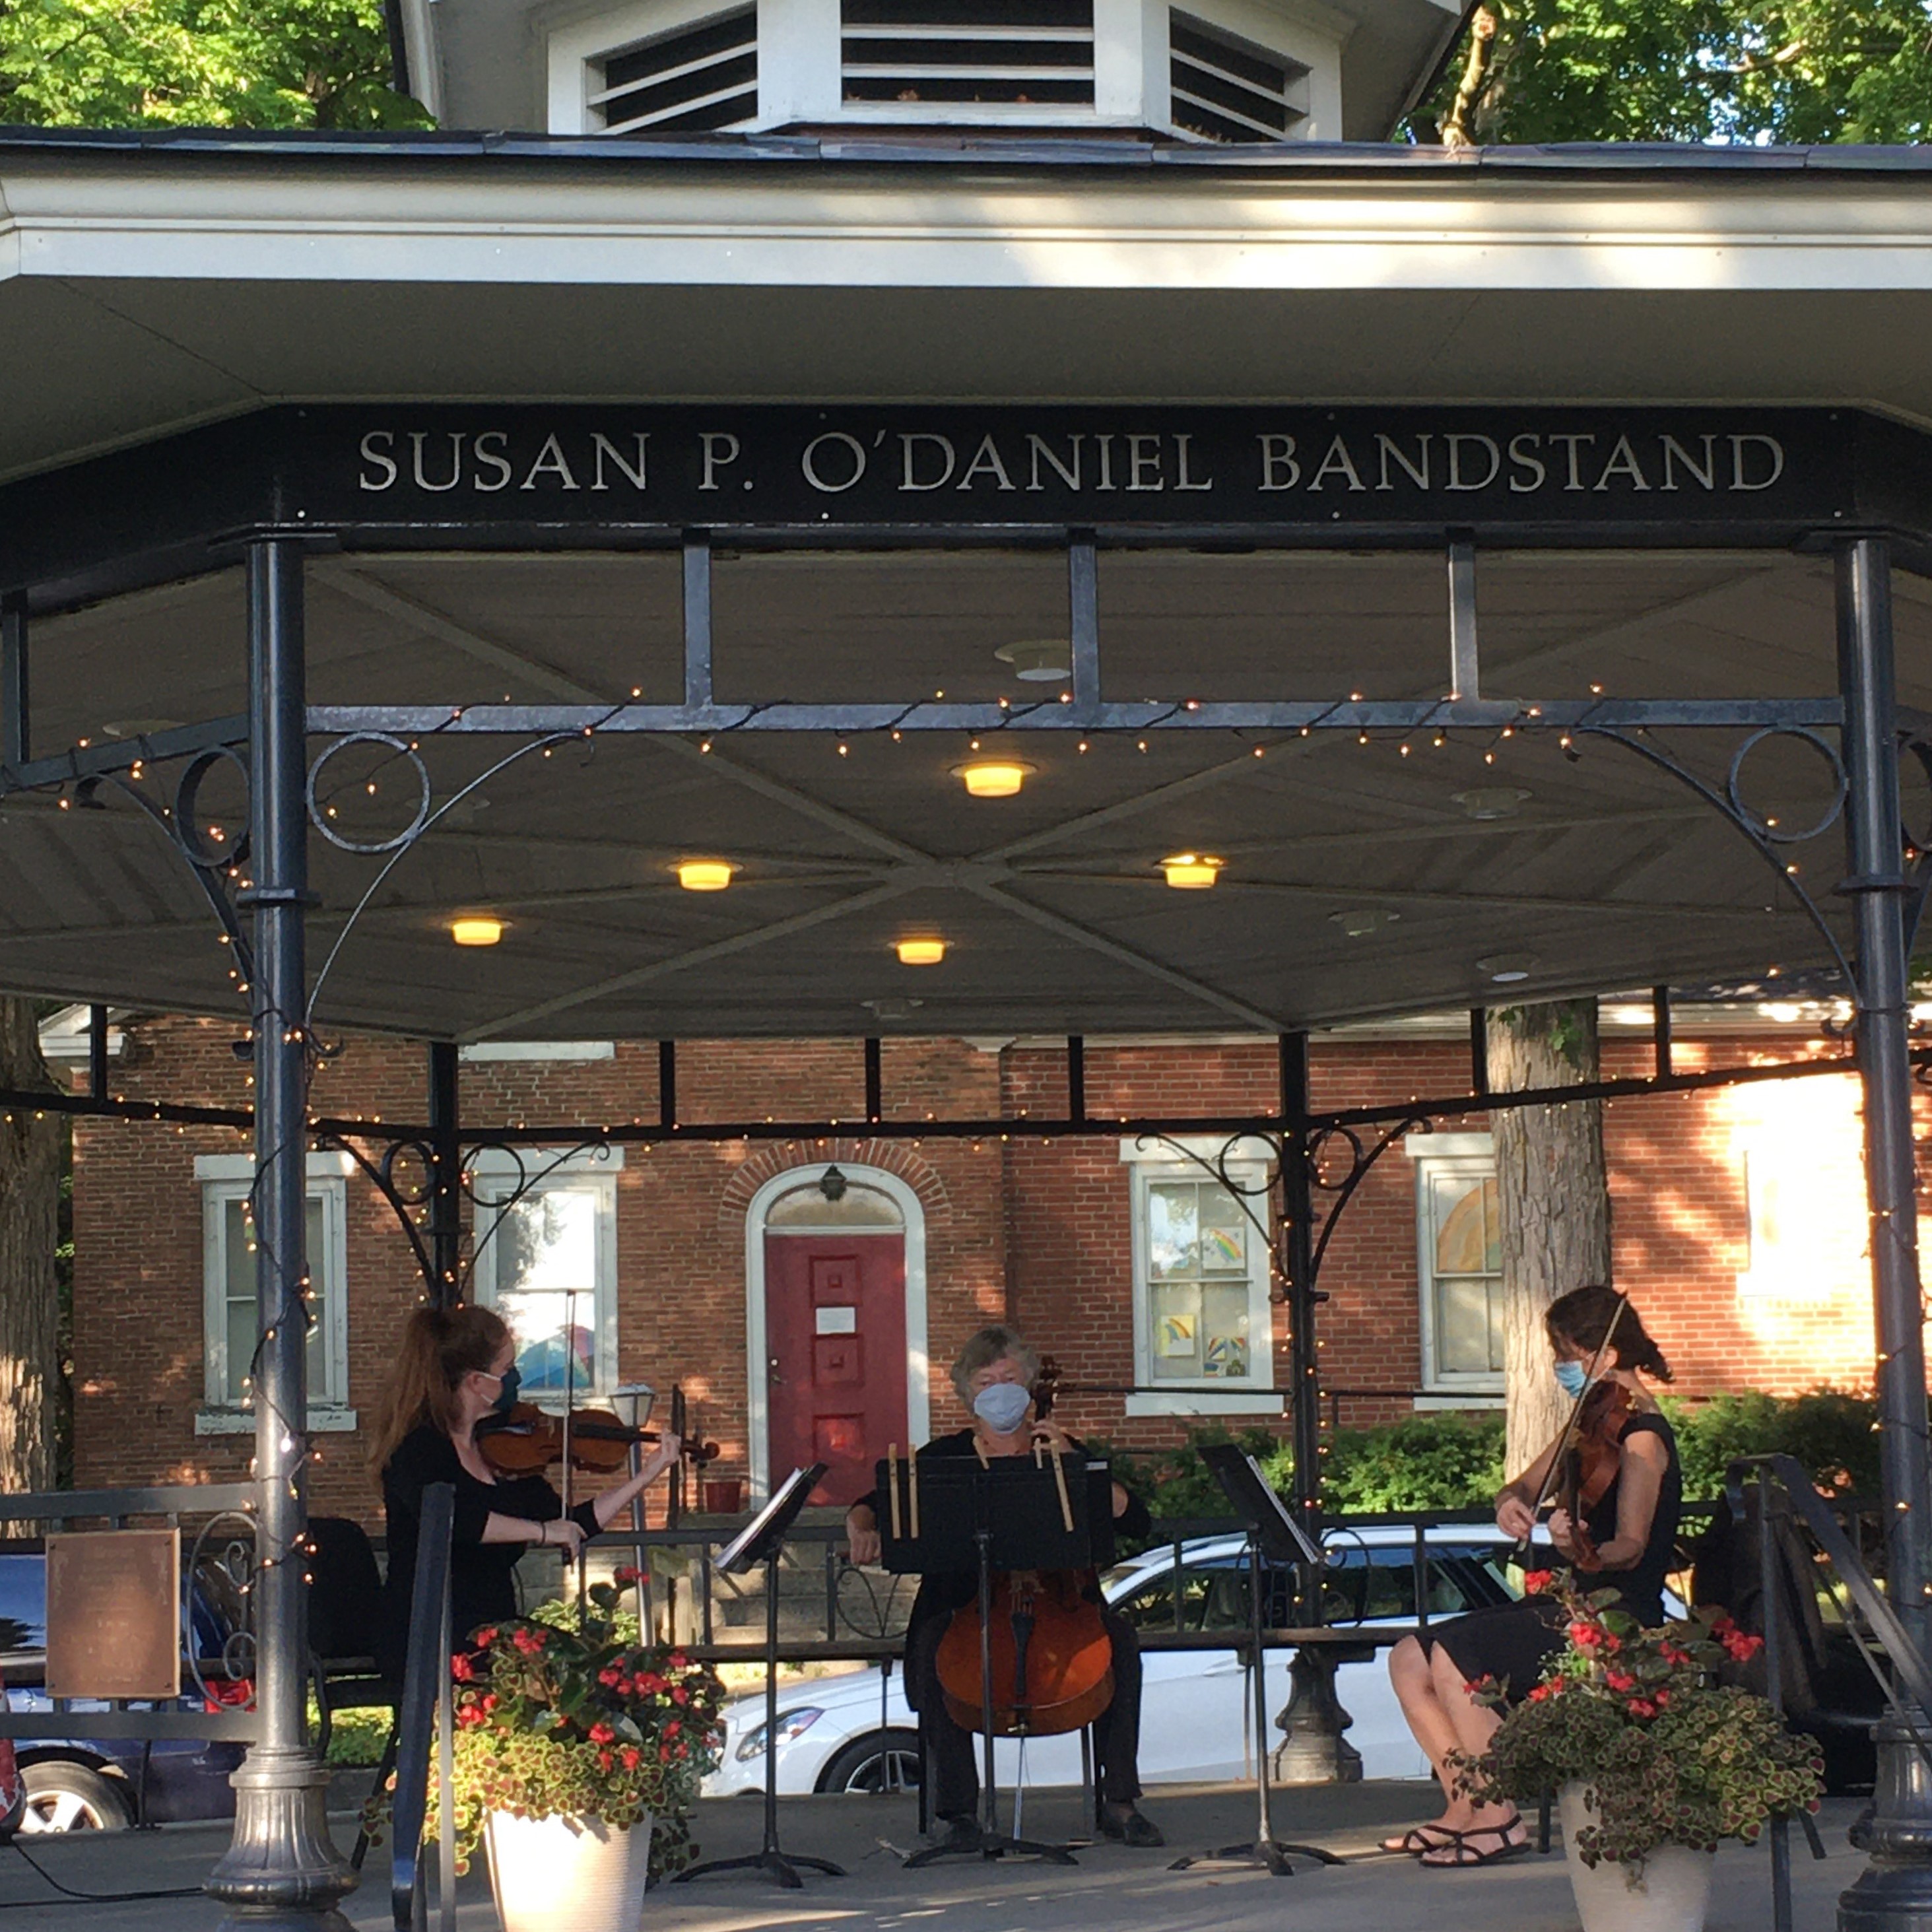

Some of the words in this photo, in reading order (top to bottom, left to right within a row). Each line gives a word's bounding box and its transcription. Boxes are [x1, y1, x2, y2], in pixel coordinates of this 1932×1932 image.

[359, 431, 650, 492] SUSAN
[698, 433, 753, 491] P.
[801, 429, 1213, 493] O'DANIEL
[1256, 433, 1784, 493] BANDSTAND
